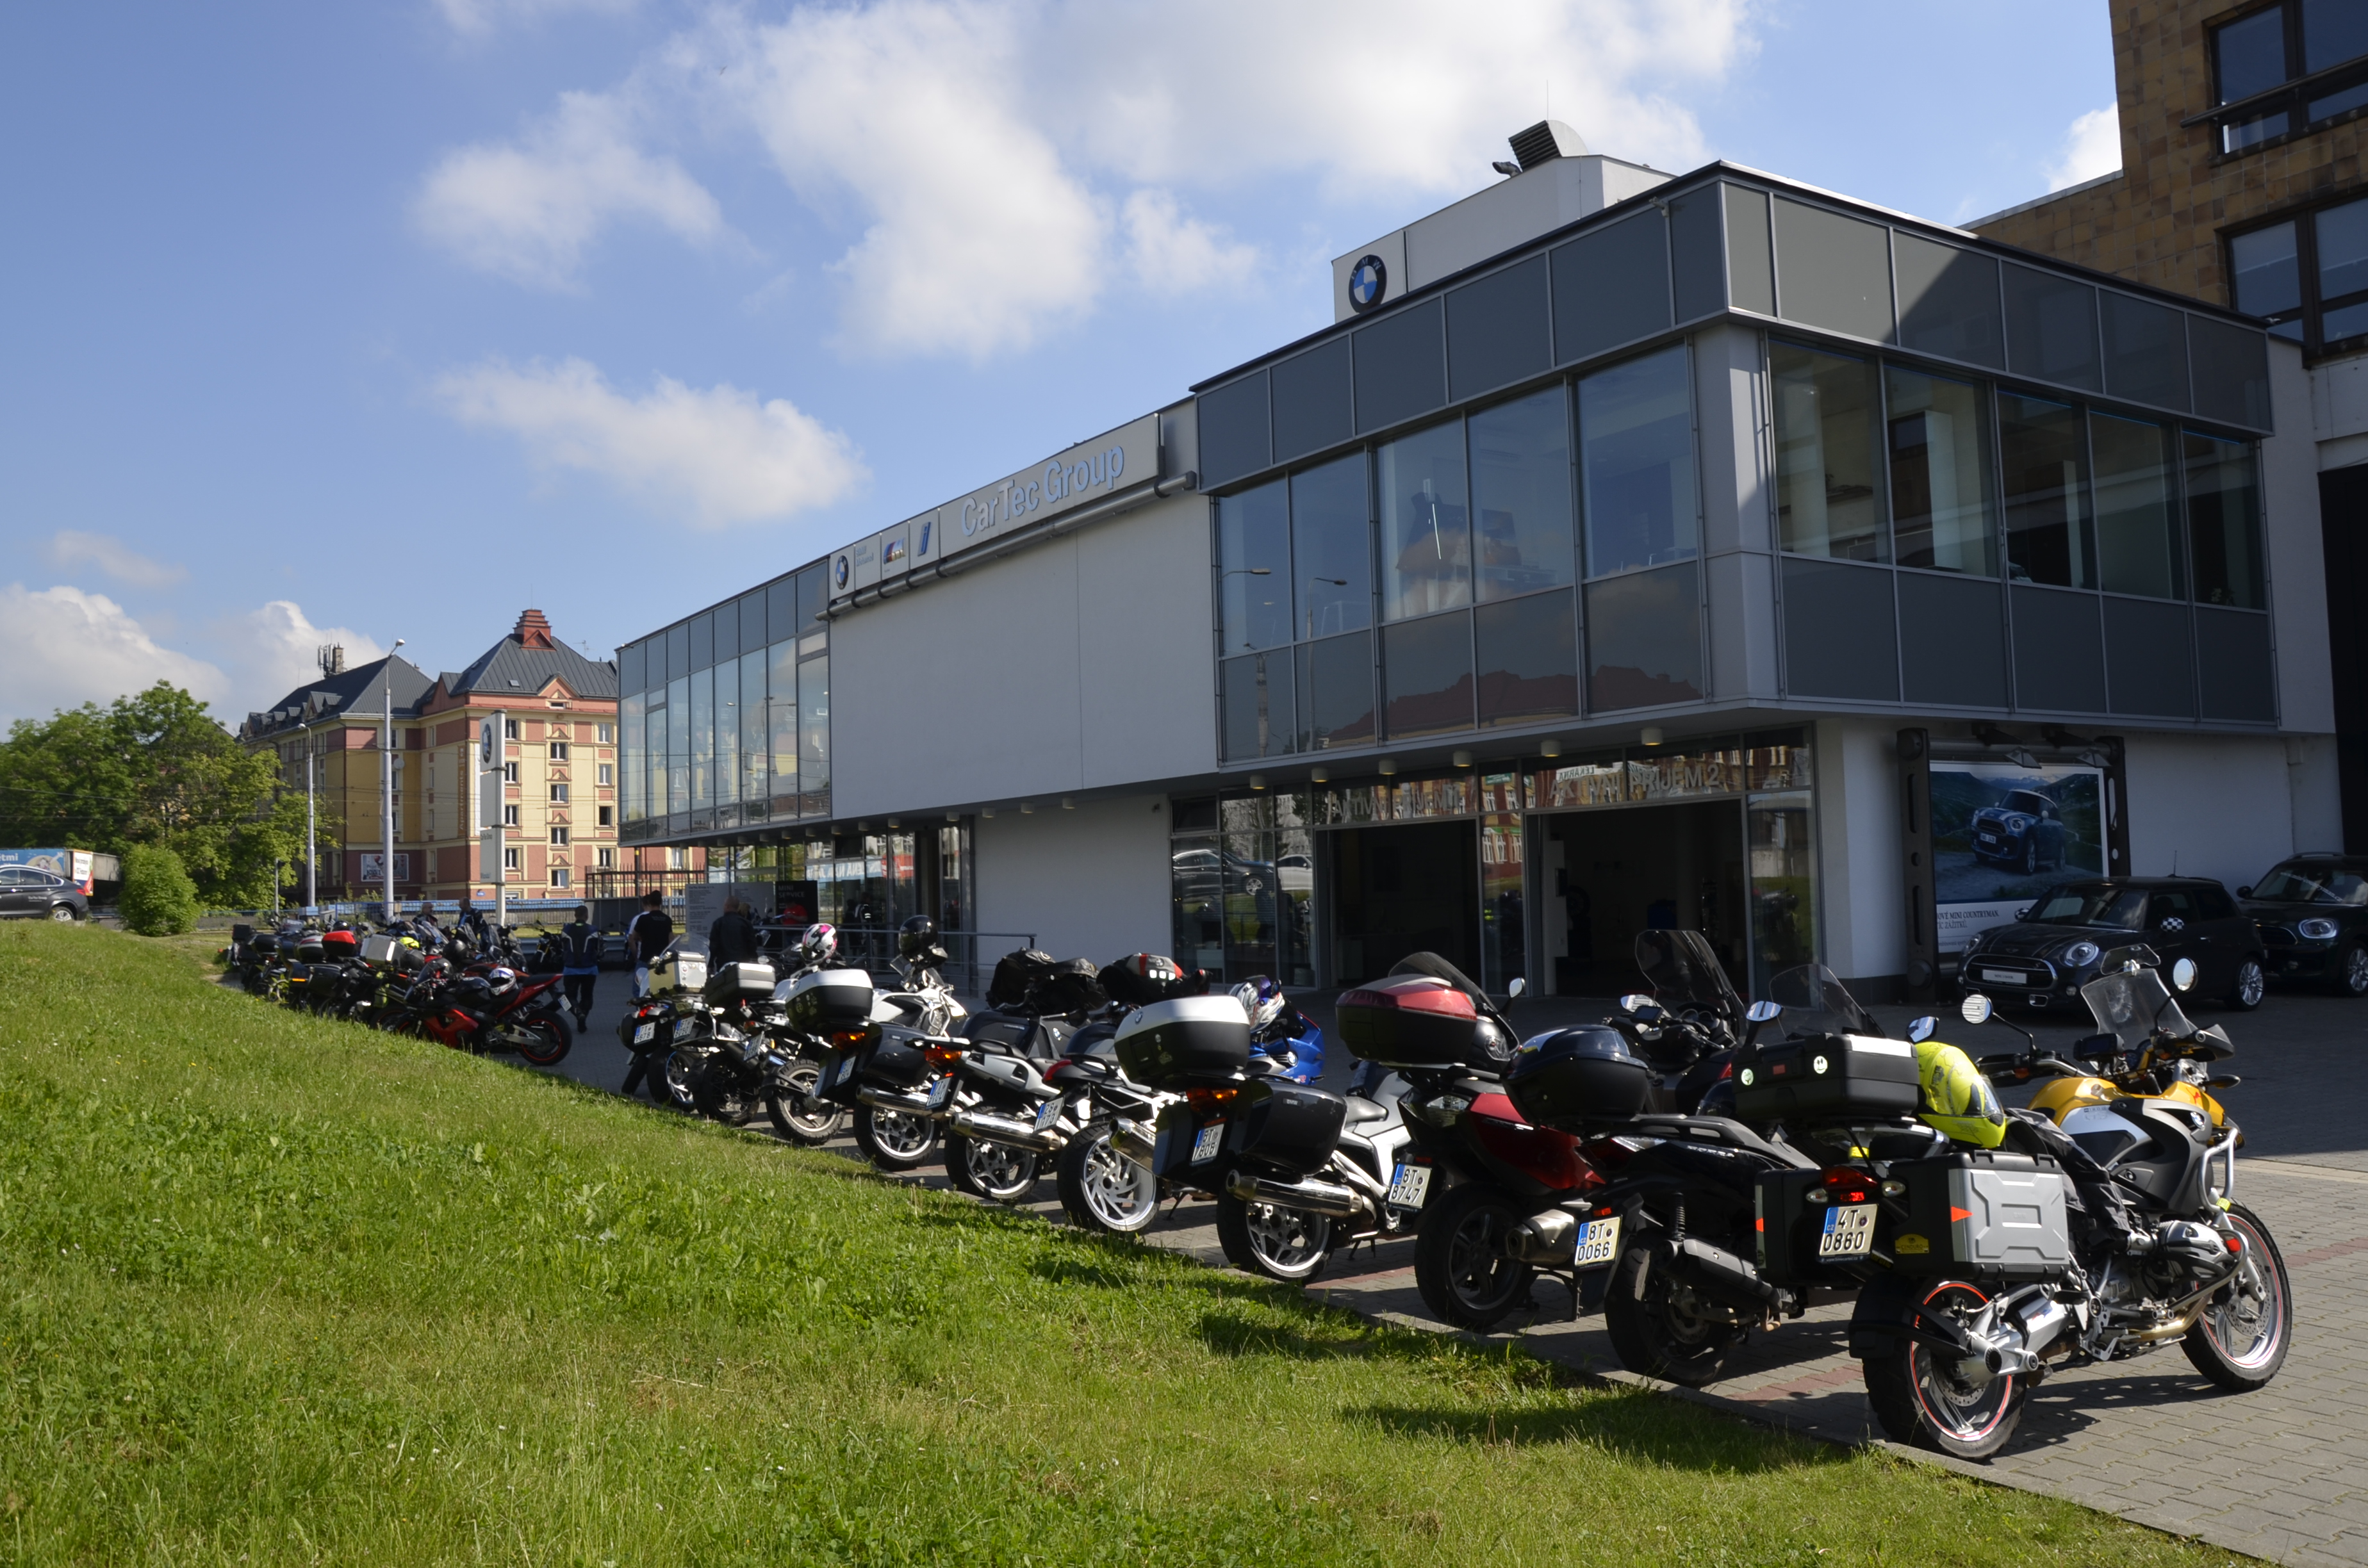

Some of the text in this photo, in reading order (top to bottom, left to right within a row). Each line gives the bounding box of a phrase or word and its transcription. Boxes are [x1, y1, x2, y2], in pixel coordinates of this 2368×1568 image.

[962, 446, 1124, 537] CarTec Group
[1707, 764, 1720, 785] 2
[1937, 911, 1948, 920] OVÉ
[1403, 1169, 1419, 1185] 6T
[1391, 1185, 1422, 1204] 8747
[1838, 1209, 1860, 1230] 4T
[1589, 1223, 1606, 1241] 8T
[1823, 1231, 1866, 1252] 0860
[1577, 1241, 1611, 1261] 0066
